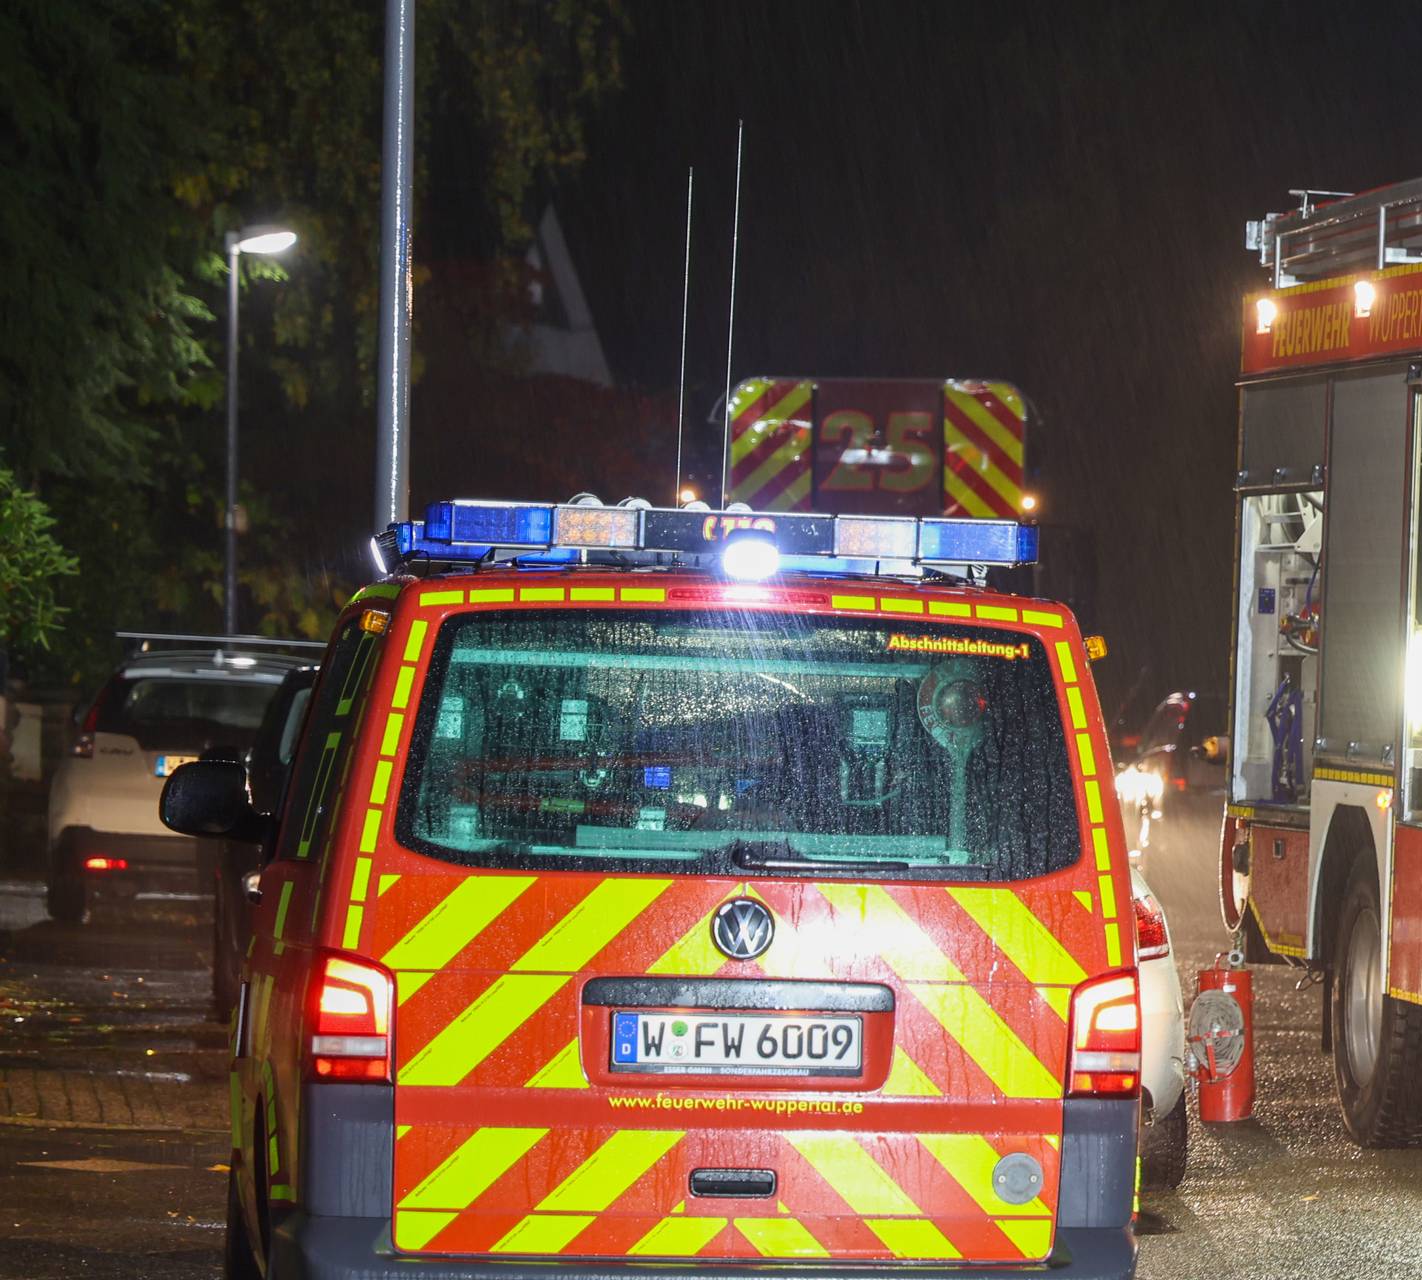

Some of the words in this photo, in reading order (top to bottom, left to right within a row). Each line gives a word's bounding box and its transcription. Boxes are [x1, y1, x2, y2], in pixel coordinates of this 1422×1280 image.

[1272, 302, 1351, 358] FEUERWEHR
[819, 408, 936, 493] 25
[888, 634, 1031, 660] Abschnittsleitung-1
[621, 1043, 631, 1055] D
[642, 1020, 665, 1057] W
[694, 1022, 745, 1059] FW
[756, 1023, 853, 1060] 6009
[608, 1093, 864, 1115] www.feuerwehr-wuppertal.de
